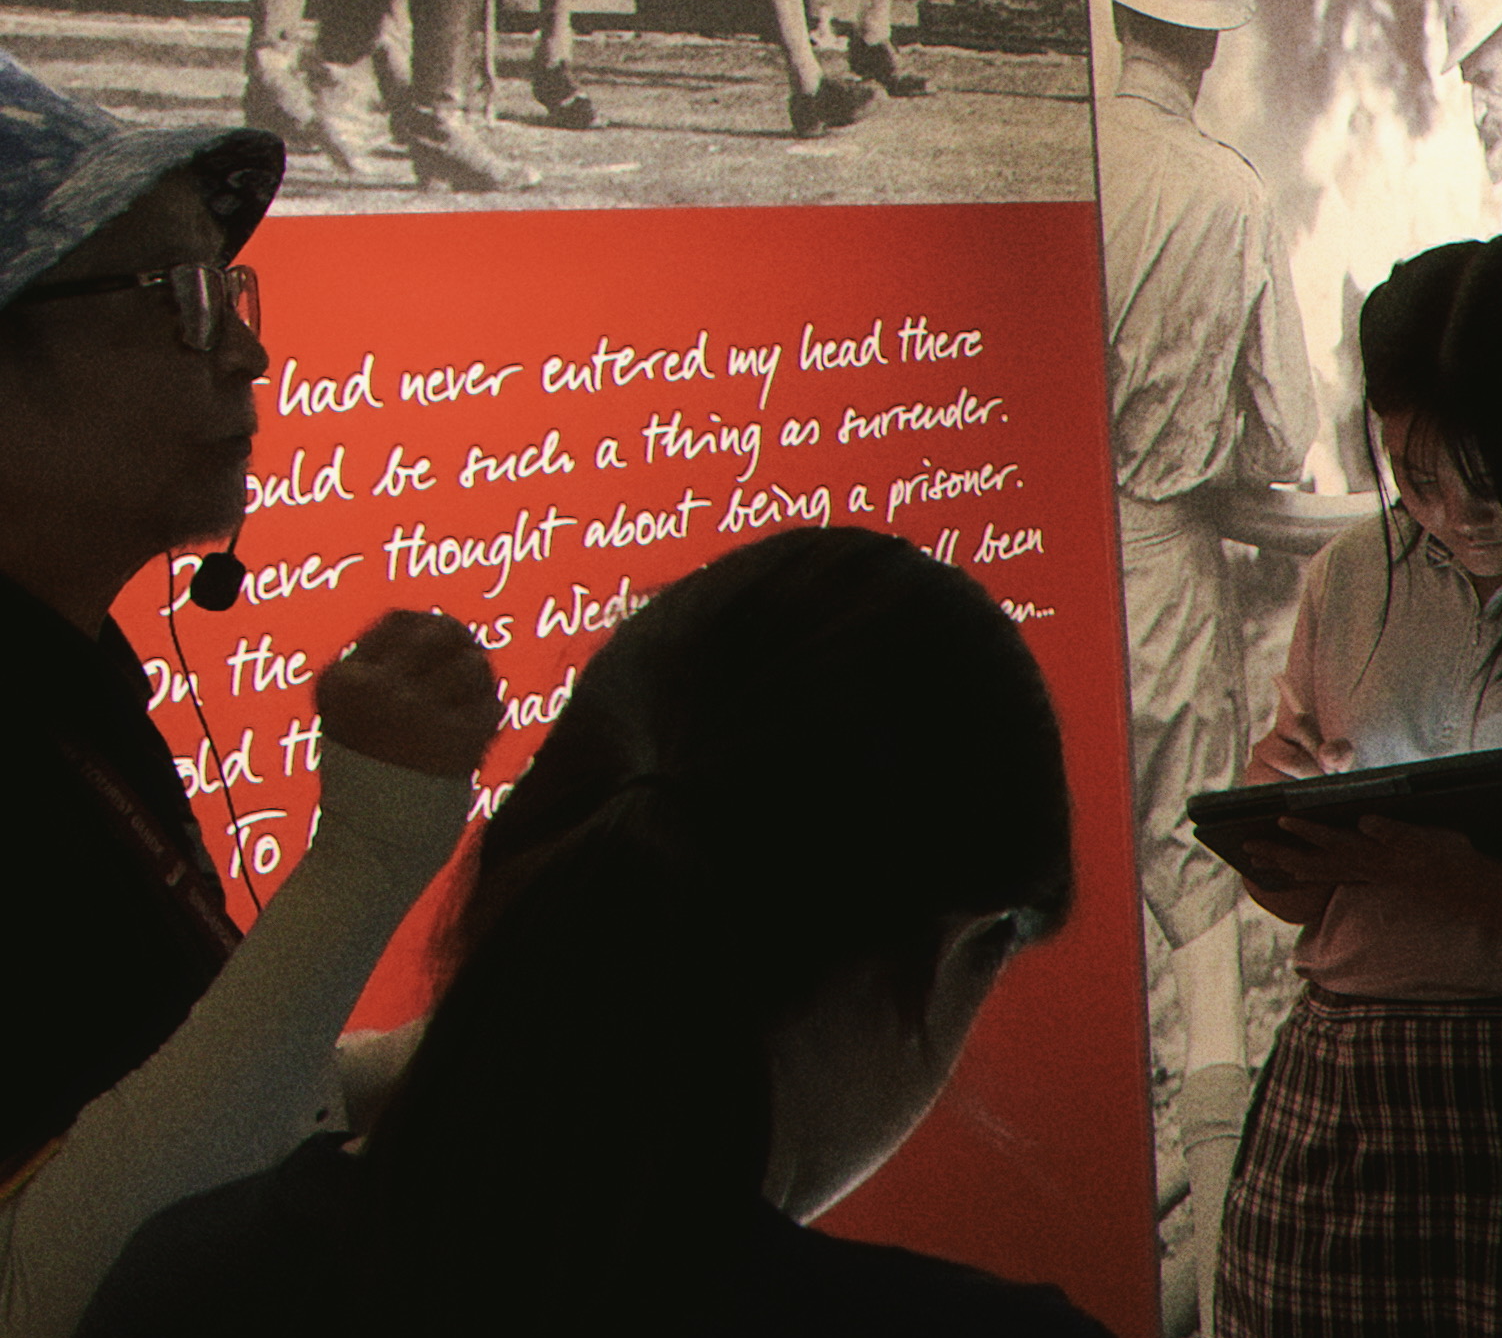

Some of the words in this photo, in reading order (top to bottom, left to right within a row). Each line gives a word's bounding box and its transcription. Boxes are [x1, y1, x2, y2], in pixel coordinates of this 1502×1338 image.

[277, 352, 384, 416] had
[399, 360, 524, 406] never
[541, 329, 715, 393] entered
[727, 344, 782, 410] my
[799, 318, 888, 372] head
[897, 315, 983, 363] there
[244, 444, 355, 514] ould
[371, 445, 437, 497] be
[458, 428, 576, 488] such
[594, 437, 628, 469] a
[641, 410, 762, 482] thing
[780, 418, 820, 446] as
[837, 387, 1009, 444] surrender.
[383, 505, 578, 599] thought
[583, 487, 713, 547] about
[717, 483, 832, 532] being
[848, 484, 875, 513] a
[886, 457, 1024, 523] prisoner.
[226, 633, 313, 697] the
[972, 522, 1045, 563] been
[173, 728, 263, 799] old
[226, 809, 288, 879] To
